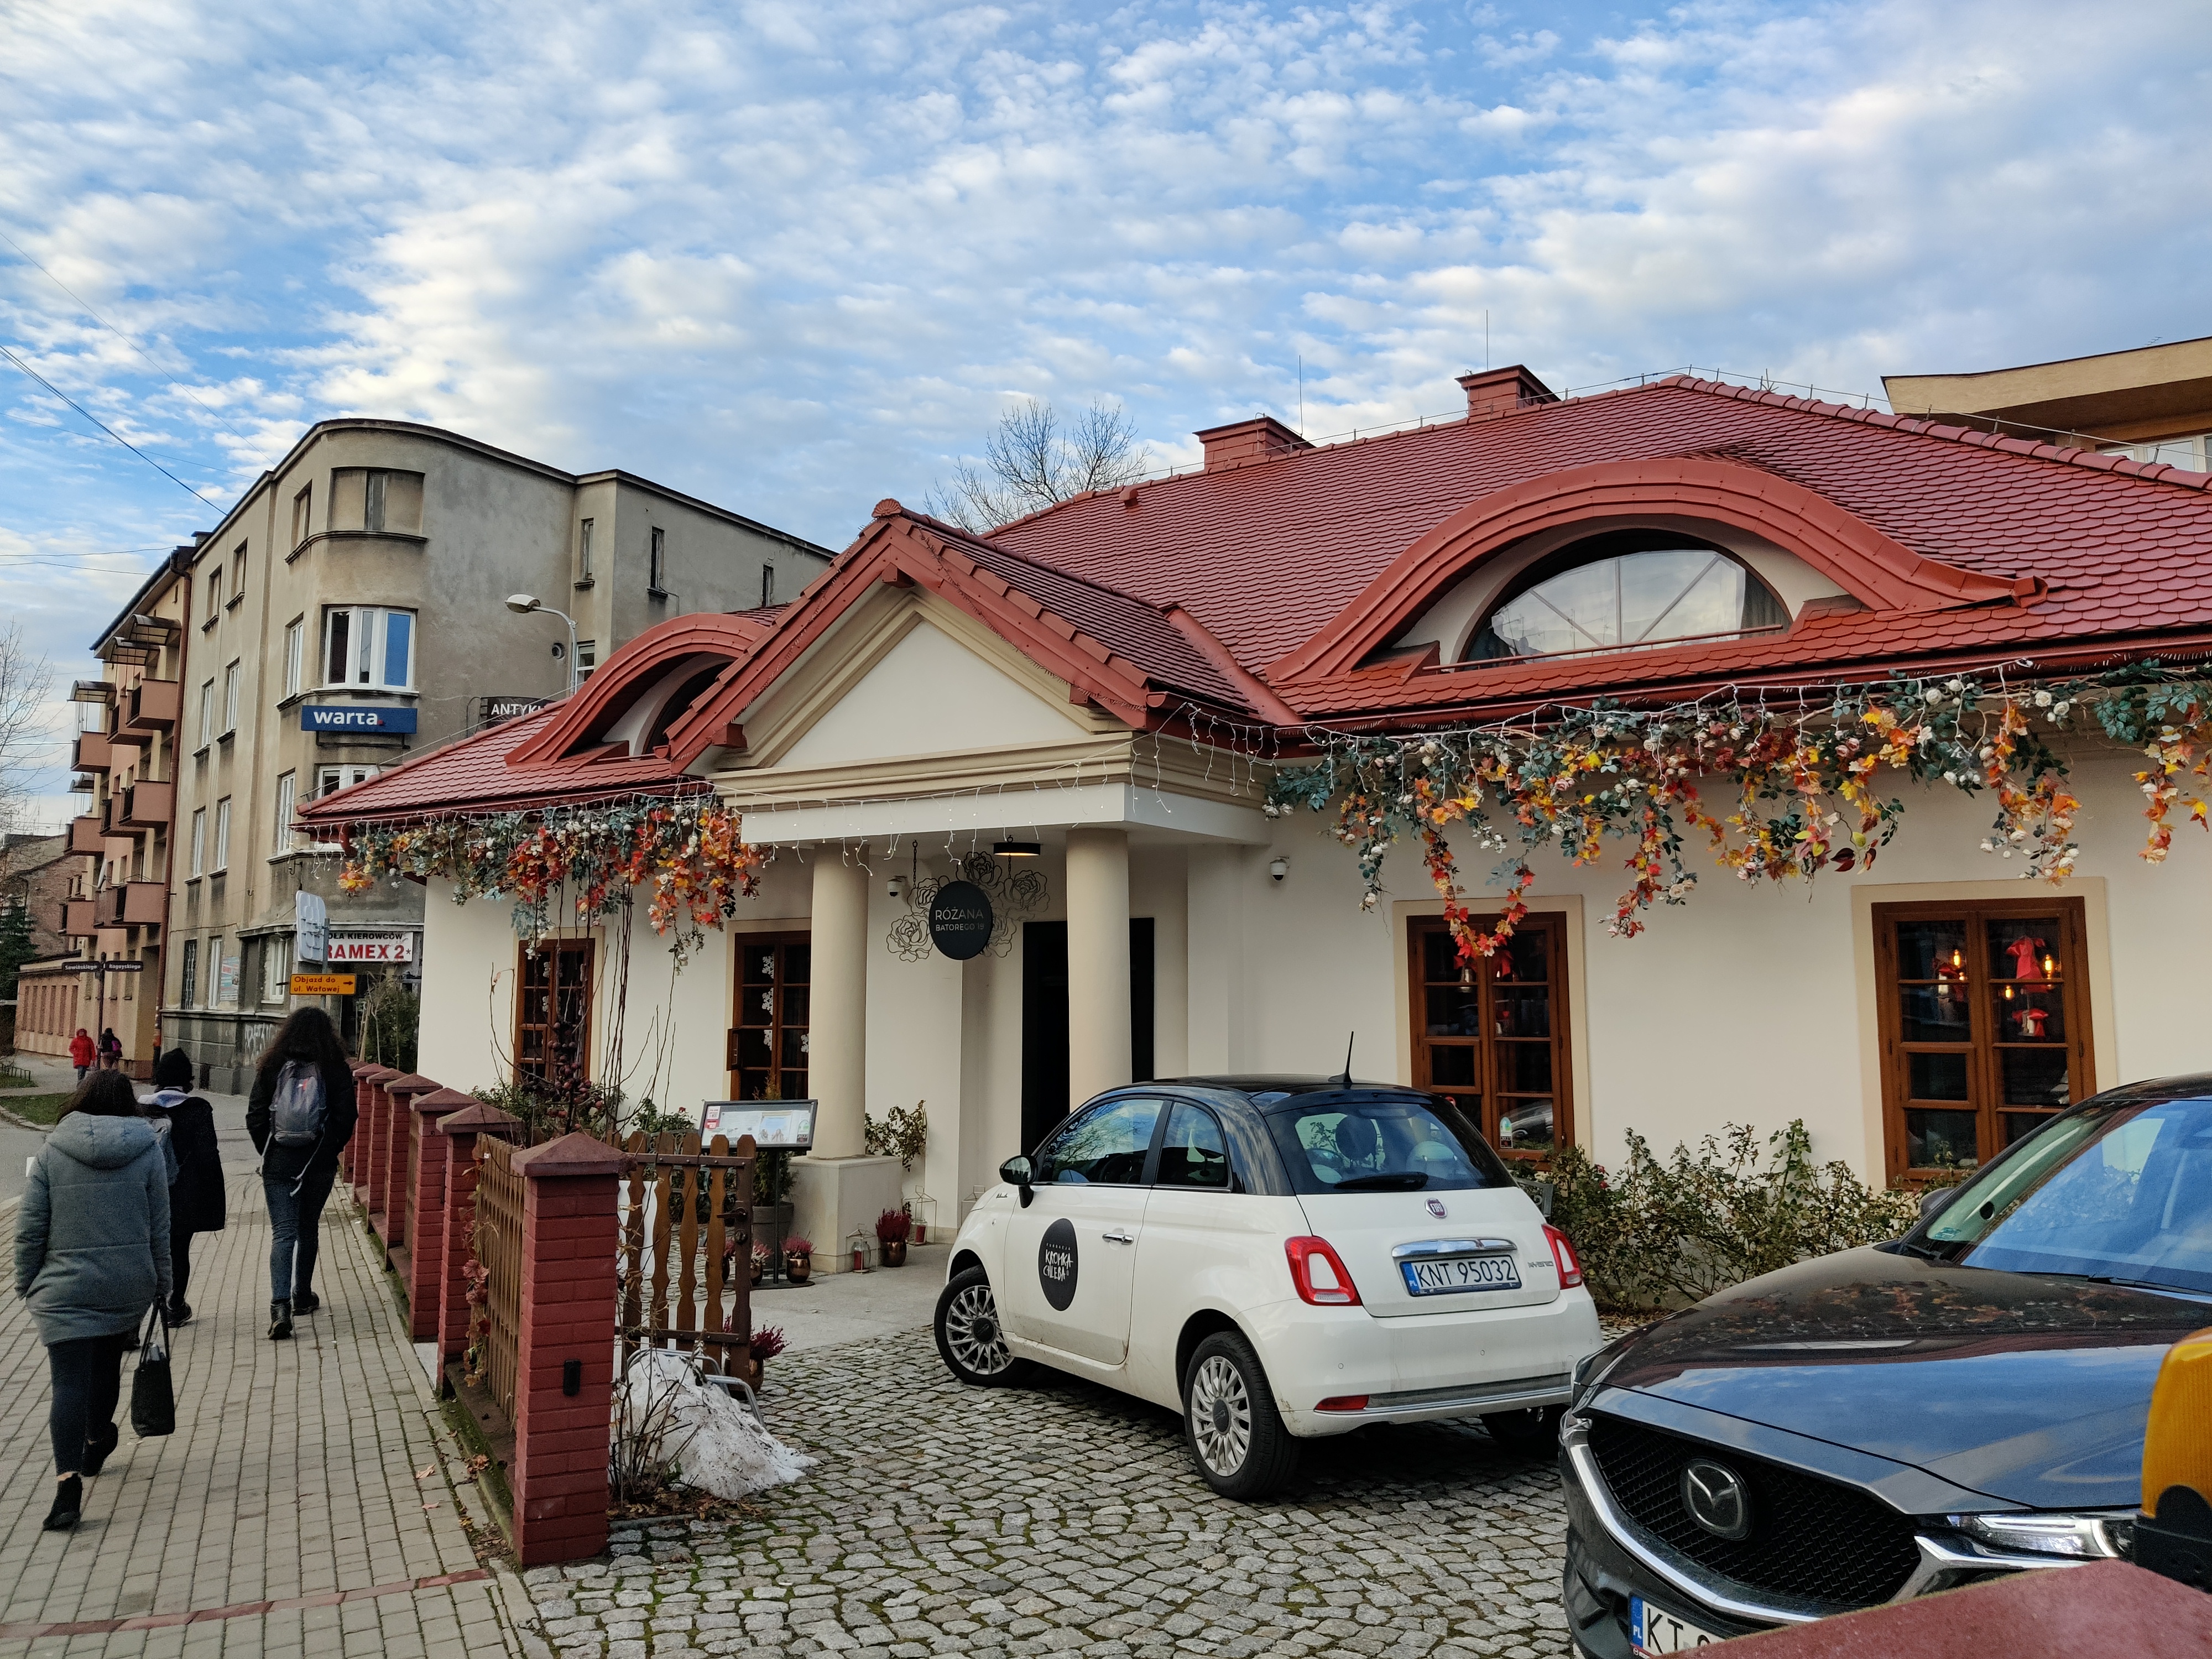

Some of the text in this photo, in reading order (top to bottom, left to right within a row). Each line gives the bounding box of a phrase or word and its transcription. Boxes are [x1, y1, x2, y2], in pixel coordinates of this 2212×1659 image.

[935, 906, 984, 921] RÓŻANA
[936, 922, 975, 932] BATOREGO
[1429, 1203, 1444, 1213] FIAT
[1045, 1249, 1073, 1270] KROMKA
[1043, 1264, 1066, 1282] CHLEBA
[1413, 1259, 1516, 1288] KNT 95032
[1633, 1624, 1642, 1640] PL
